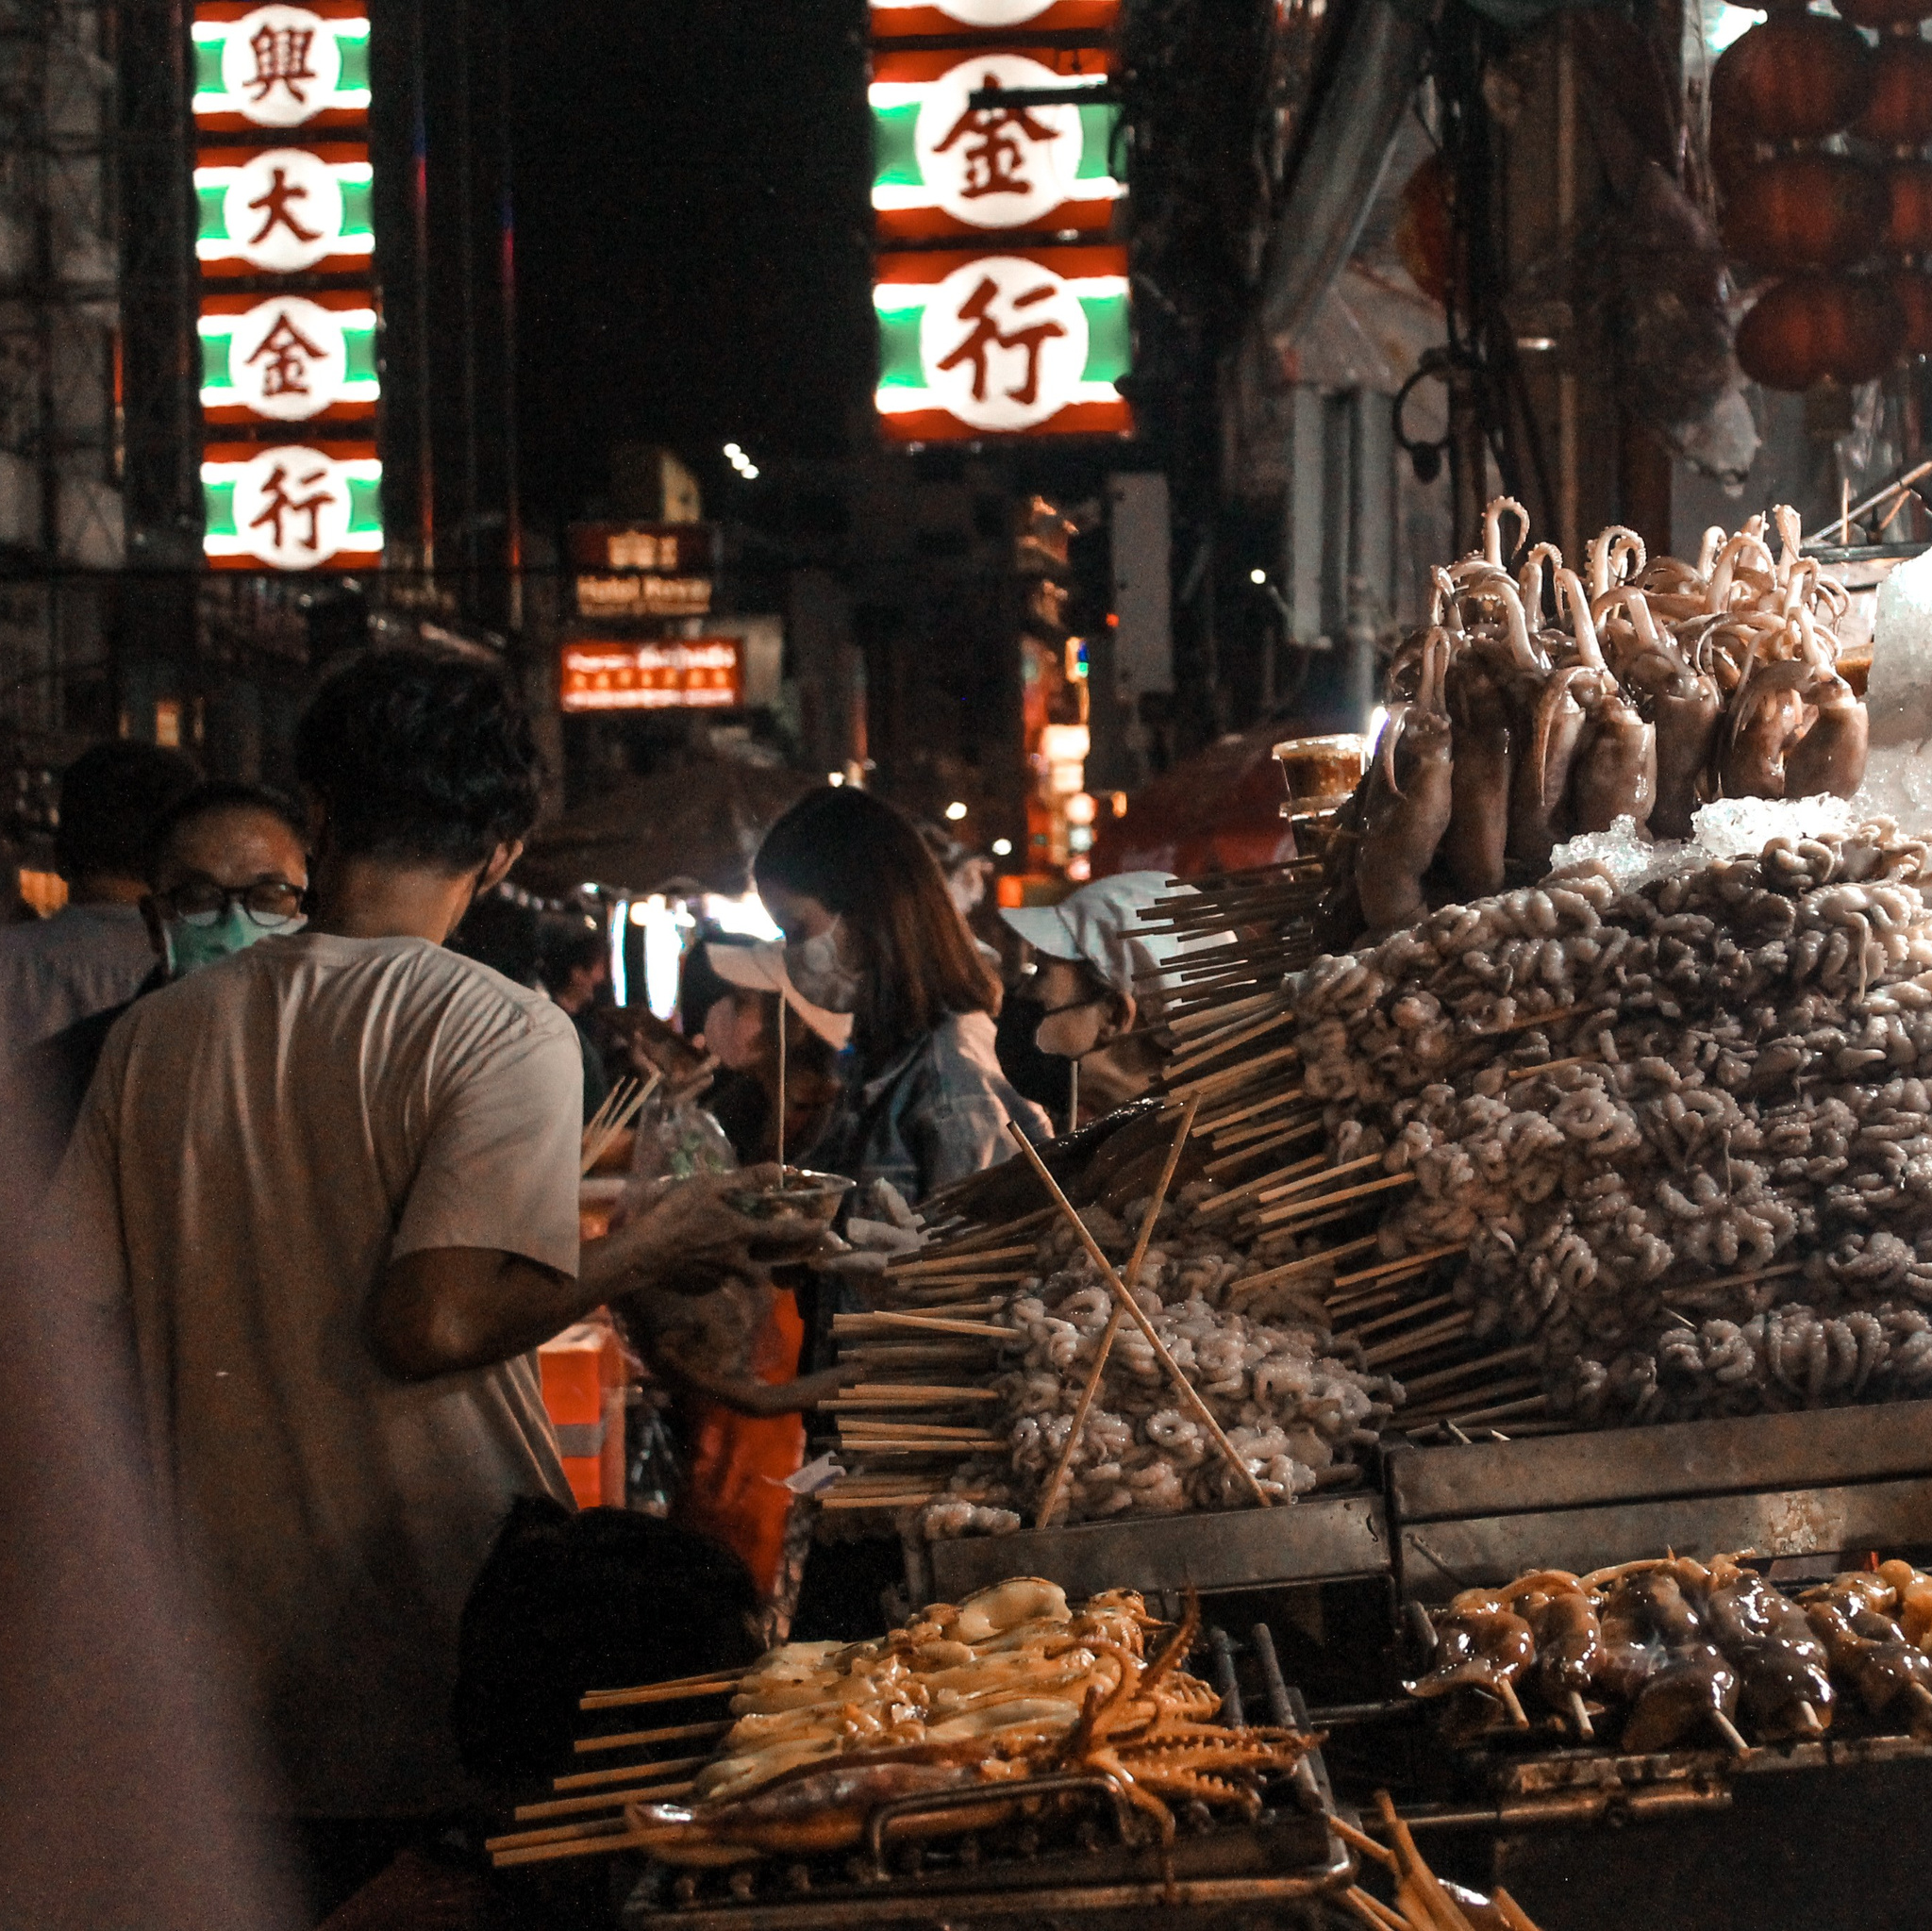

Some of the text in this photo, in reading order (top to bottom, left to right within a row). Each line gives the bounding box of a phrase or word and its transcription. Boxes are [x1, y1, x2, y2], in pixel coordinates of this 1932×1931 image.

[243, 25, 334, 551] 興大金行
[932, 73, 1065, 406] 金行
